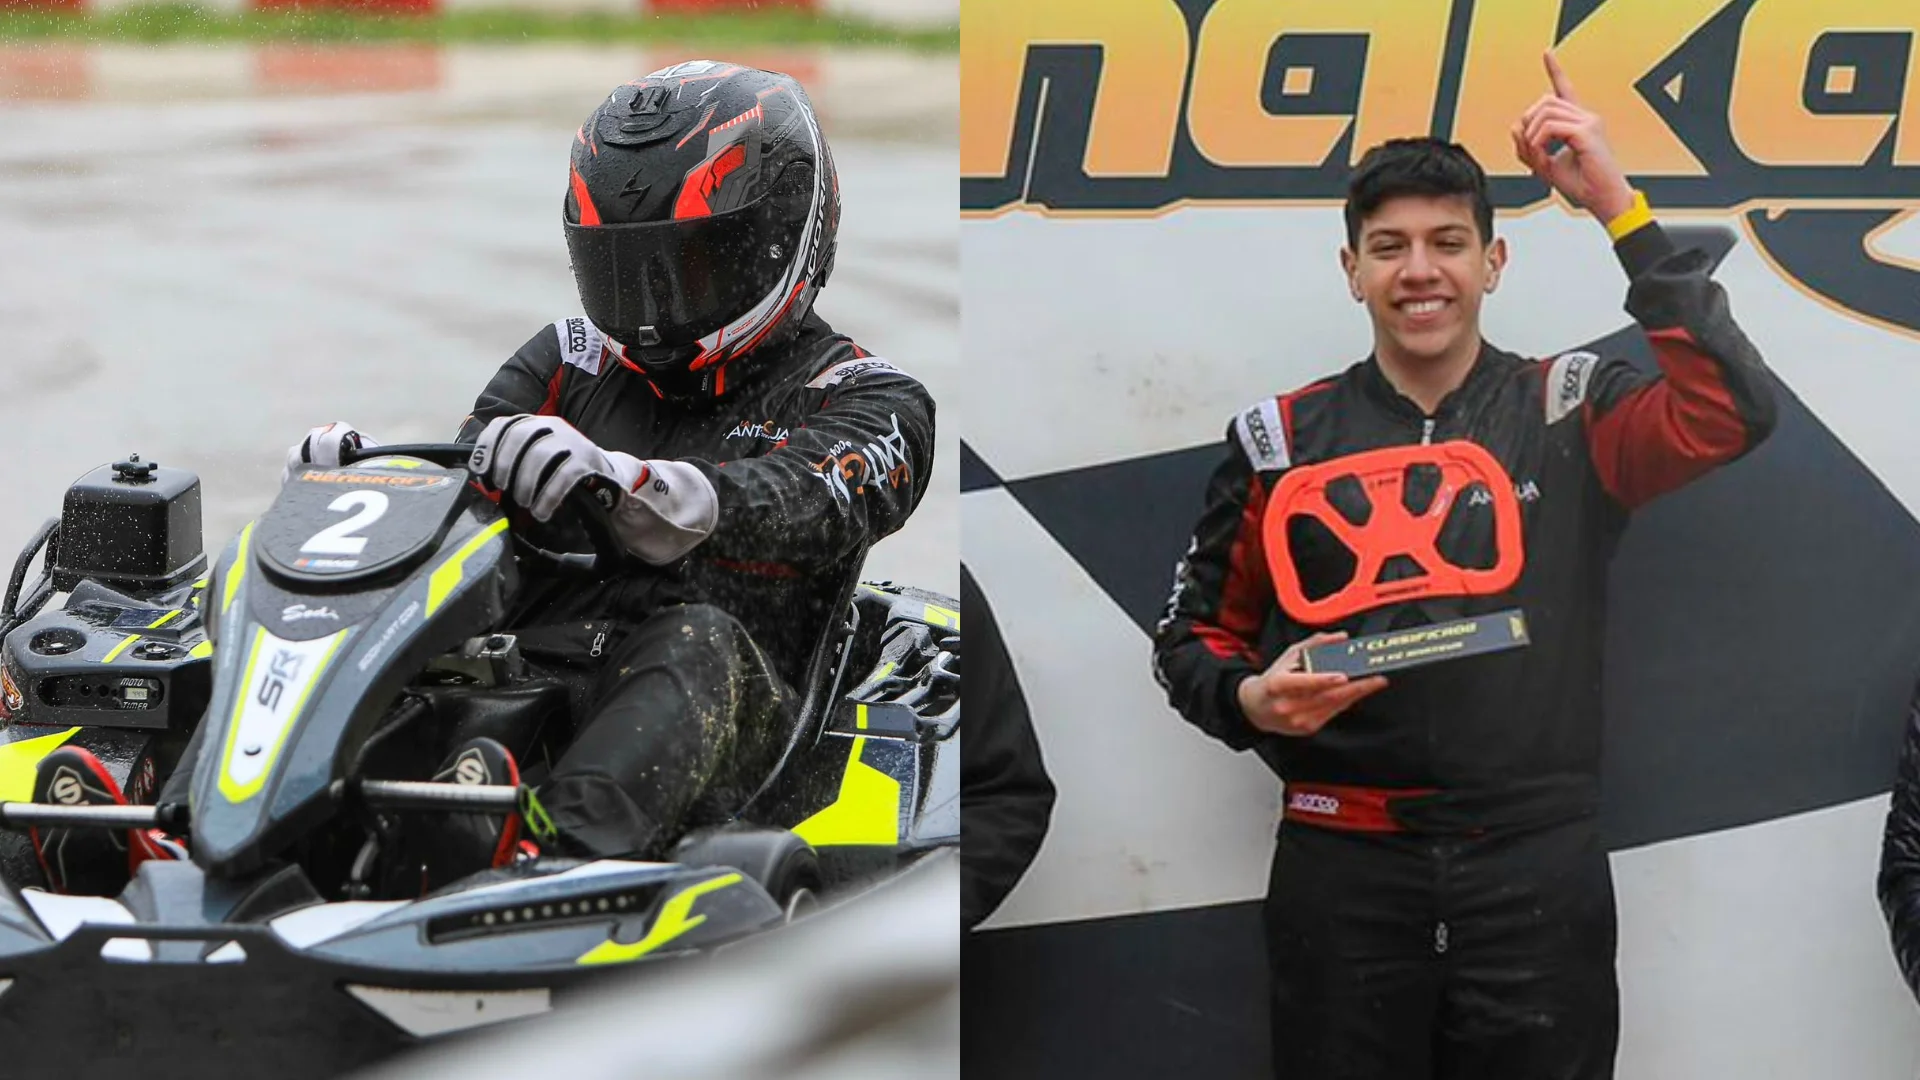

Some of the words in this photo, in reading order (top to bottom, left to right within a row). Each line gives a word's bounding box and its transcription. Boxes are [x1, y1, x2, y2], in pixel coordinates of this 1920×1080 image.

[300, 489, 390, 555] 2
[120, 678, 144, 687] MOTO
[122, 701, 149, 711] TIMER
